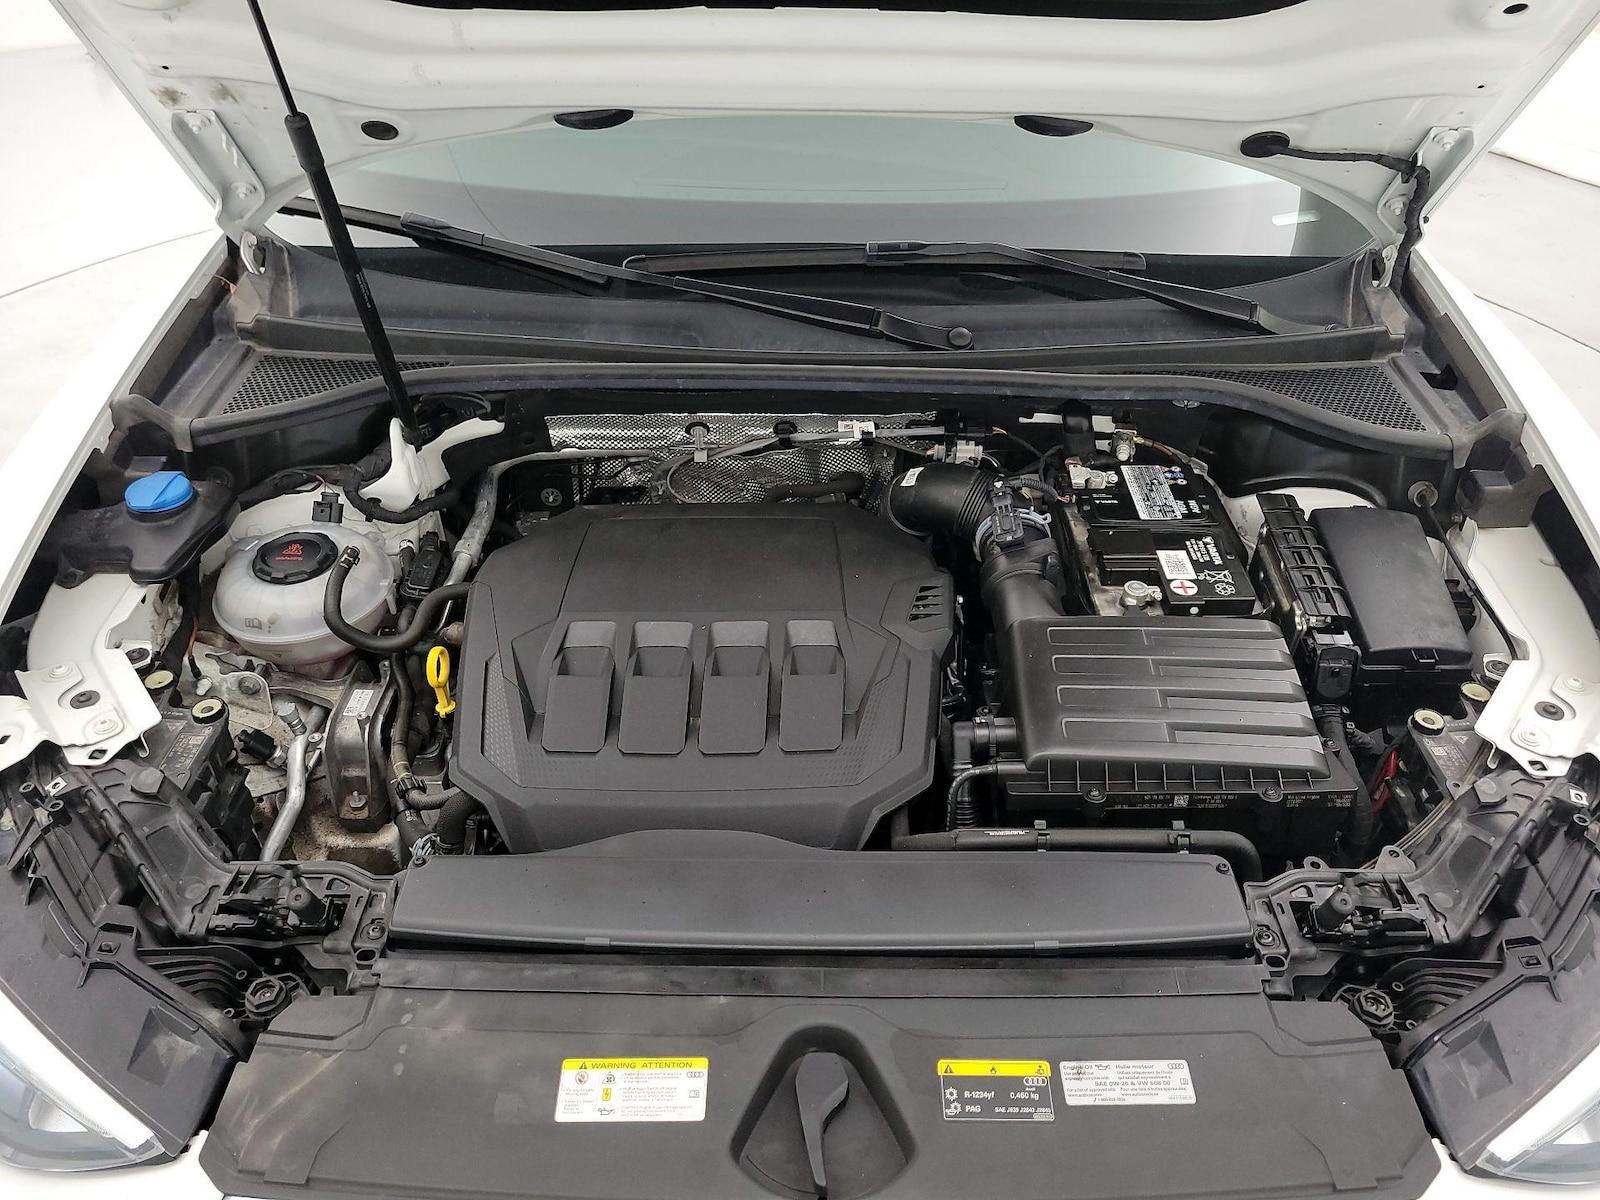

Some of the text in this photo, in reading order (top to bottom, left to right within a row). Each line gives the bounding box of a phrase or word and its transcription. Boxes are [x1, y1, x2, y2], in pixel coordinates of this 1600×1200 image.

[1206, 544, 1223, 565] VARTA
[964, 1091, 995, 1100] R-1234yf
[1031, 1091, 1039, 1100] kg
[965, 1105, 981, 1113] PAG
